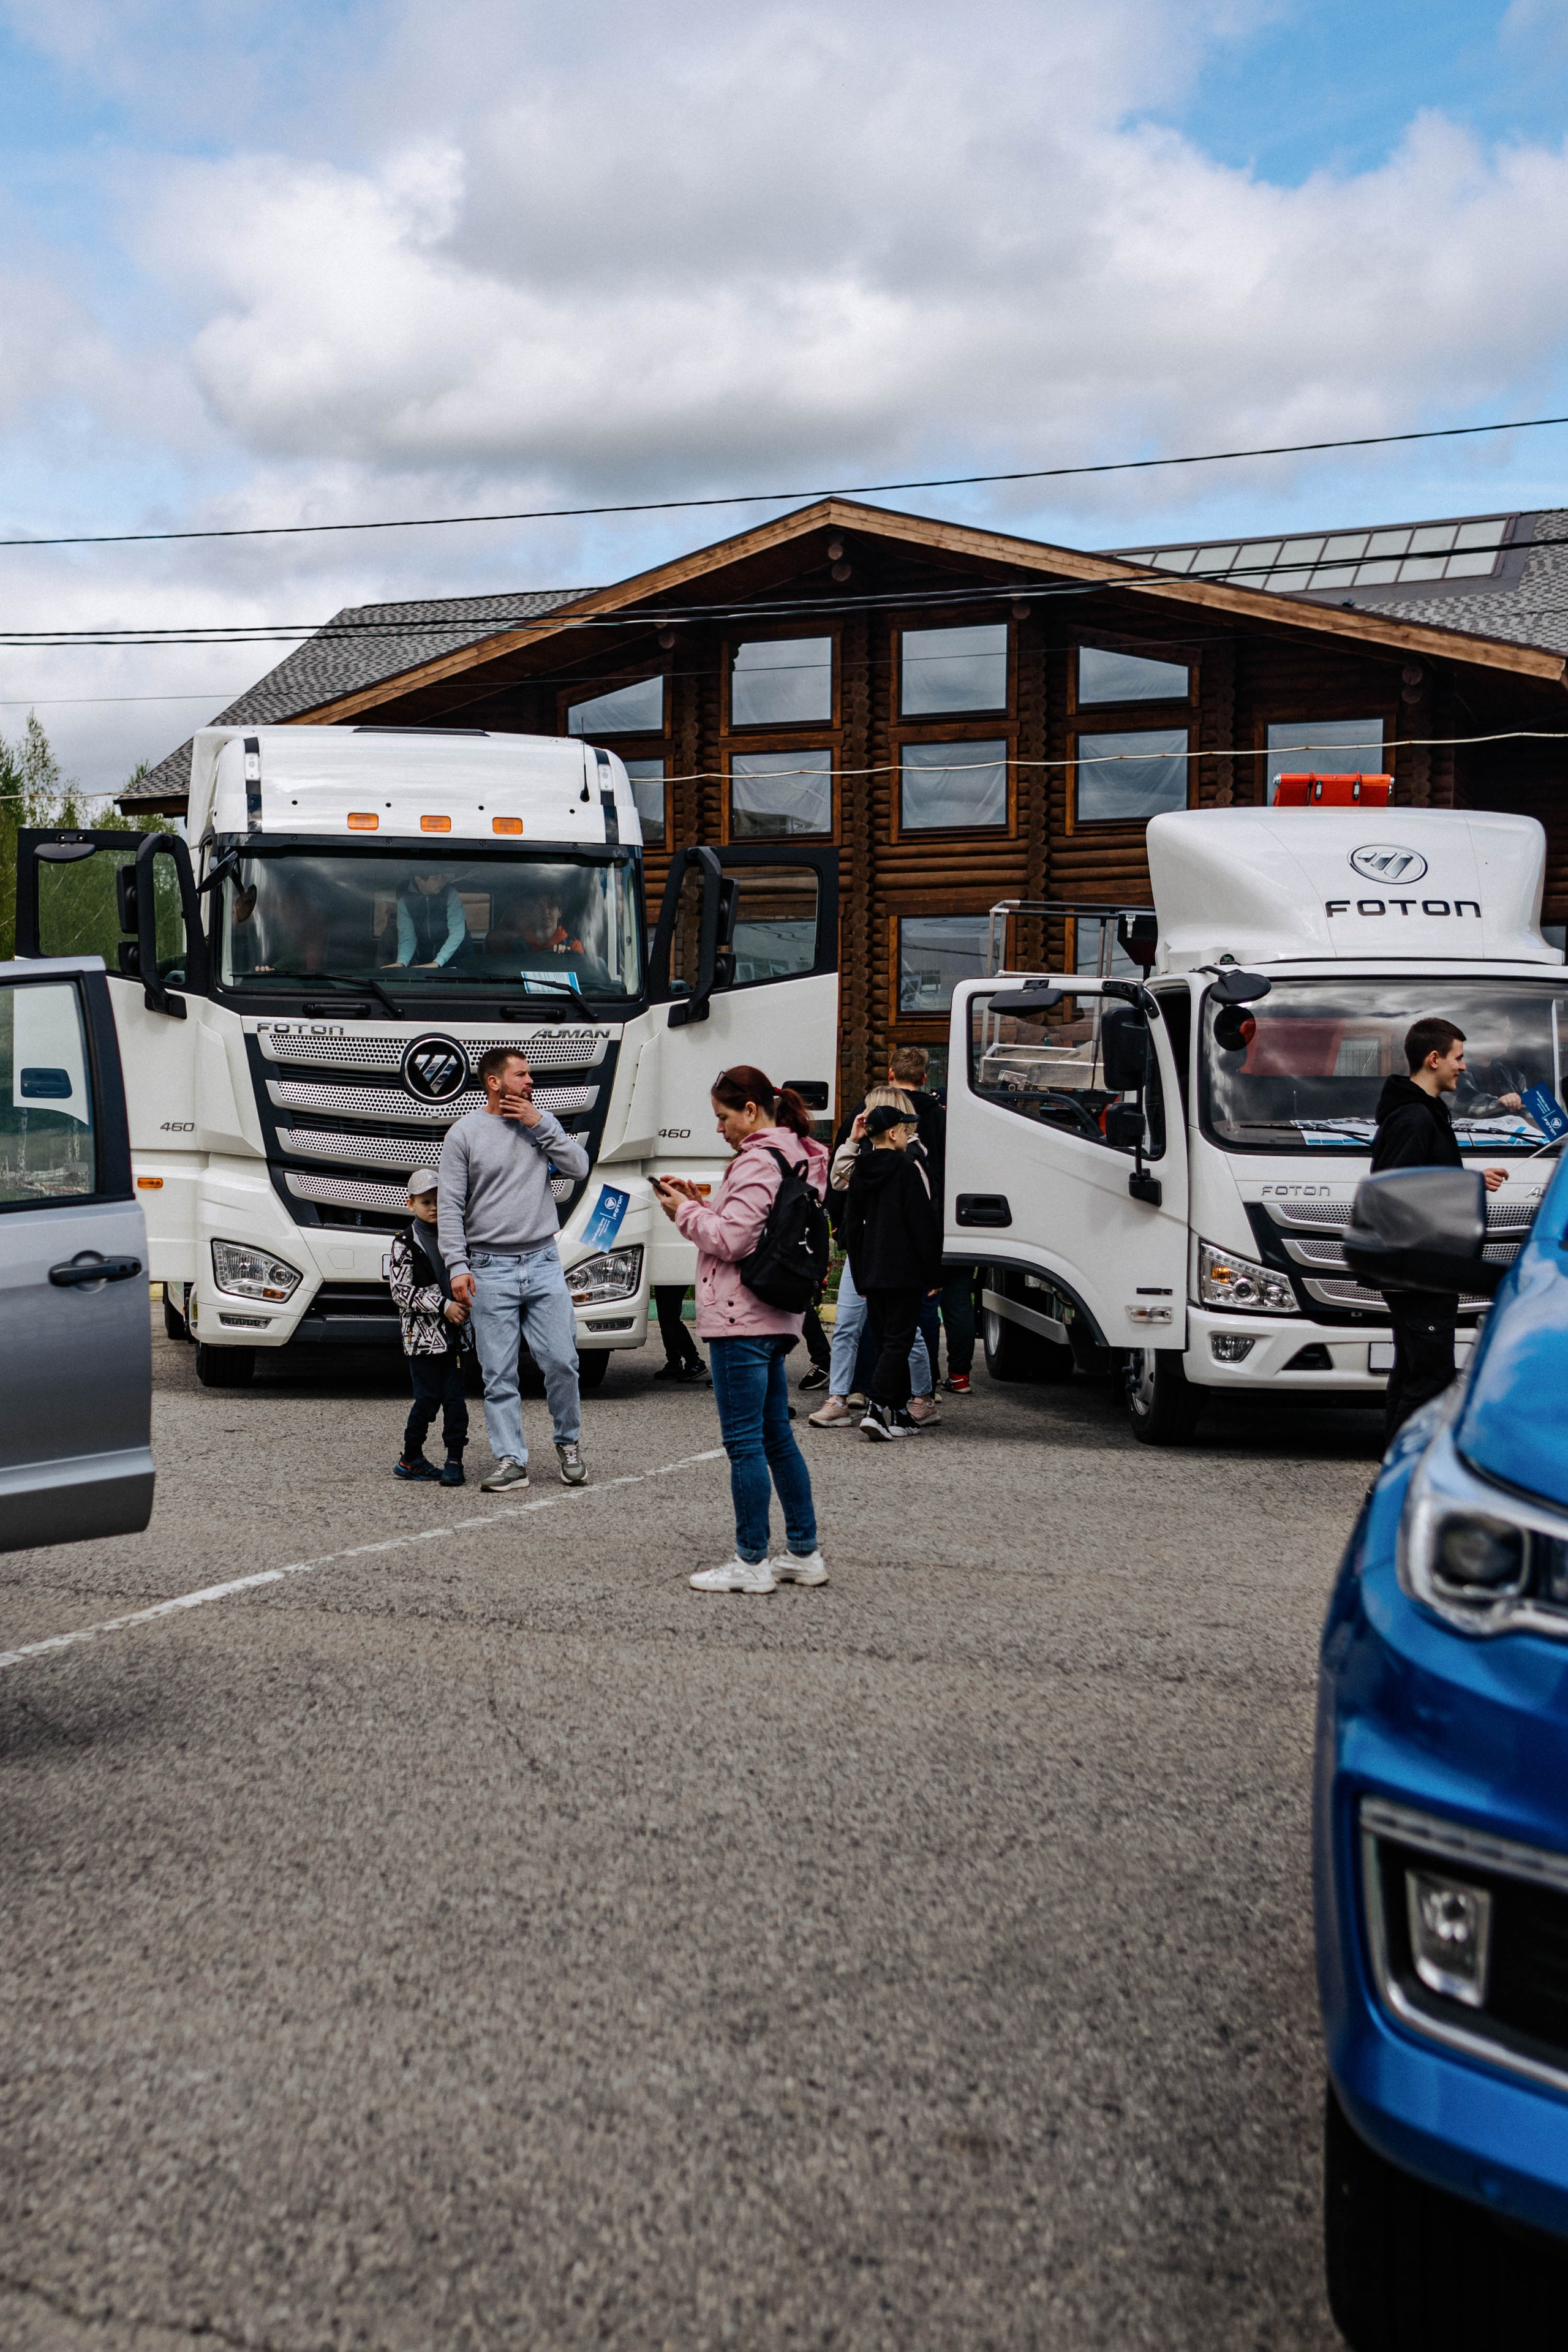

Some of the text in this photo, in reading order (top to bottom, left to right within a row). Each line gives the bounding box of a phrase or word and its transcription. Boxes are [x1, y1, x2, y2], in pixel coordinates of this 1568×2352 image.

[1325, 899, 1482, 918] FOTON
[257, 1021, 344, 1036] FOTON
[530, 1028, 611, 1039] AUMAN
[160, 1122, 195, 1132] 460
[658, 1129, 691, 1138] 460
[1261, 1185, 1330, 1196] FOTON
[612, 1194, 624, 1218] FOTON
